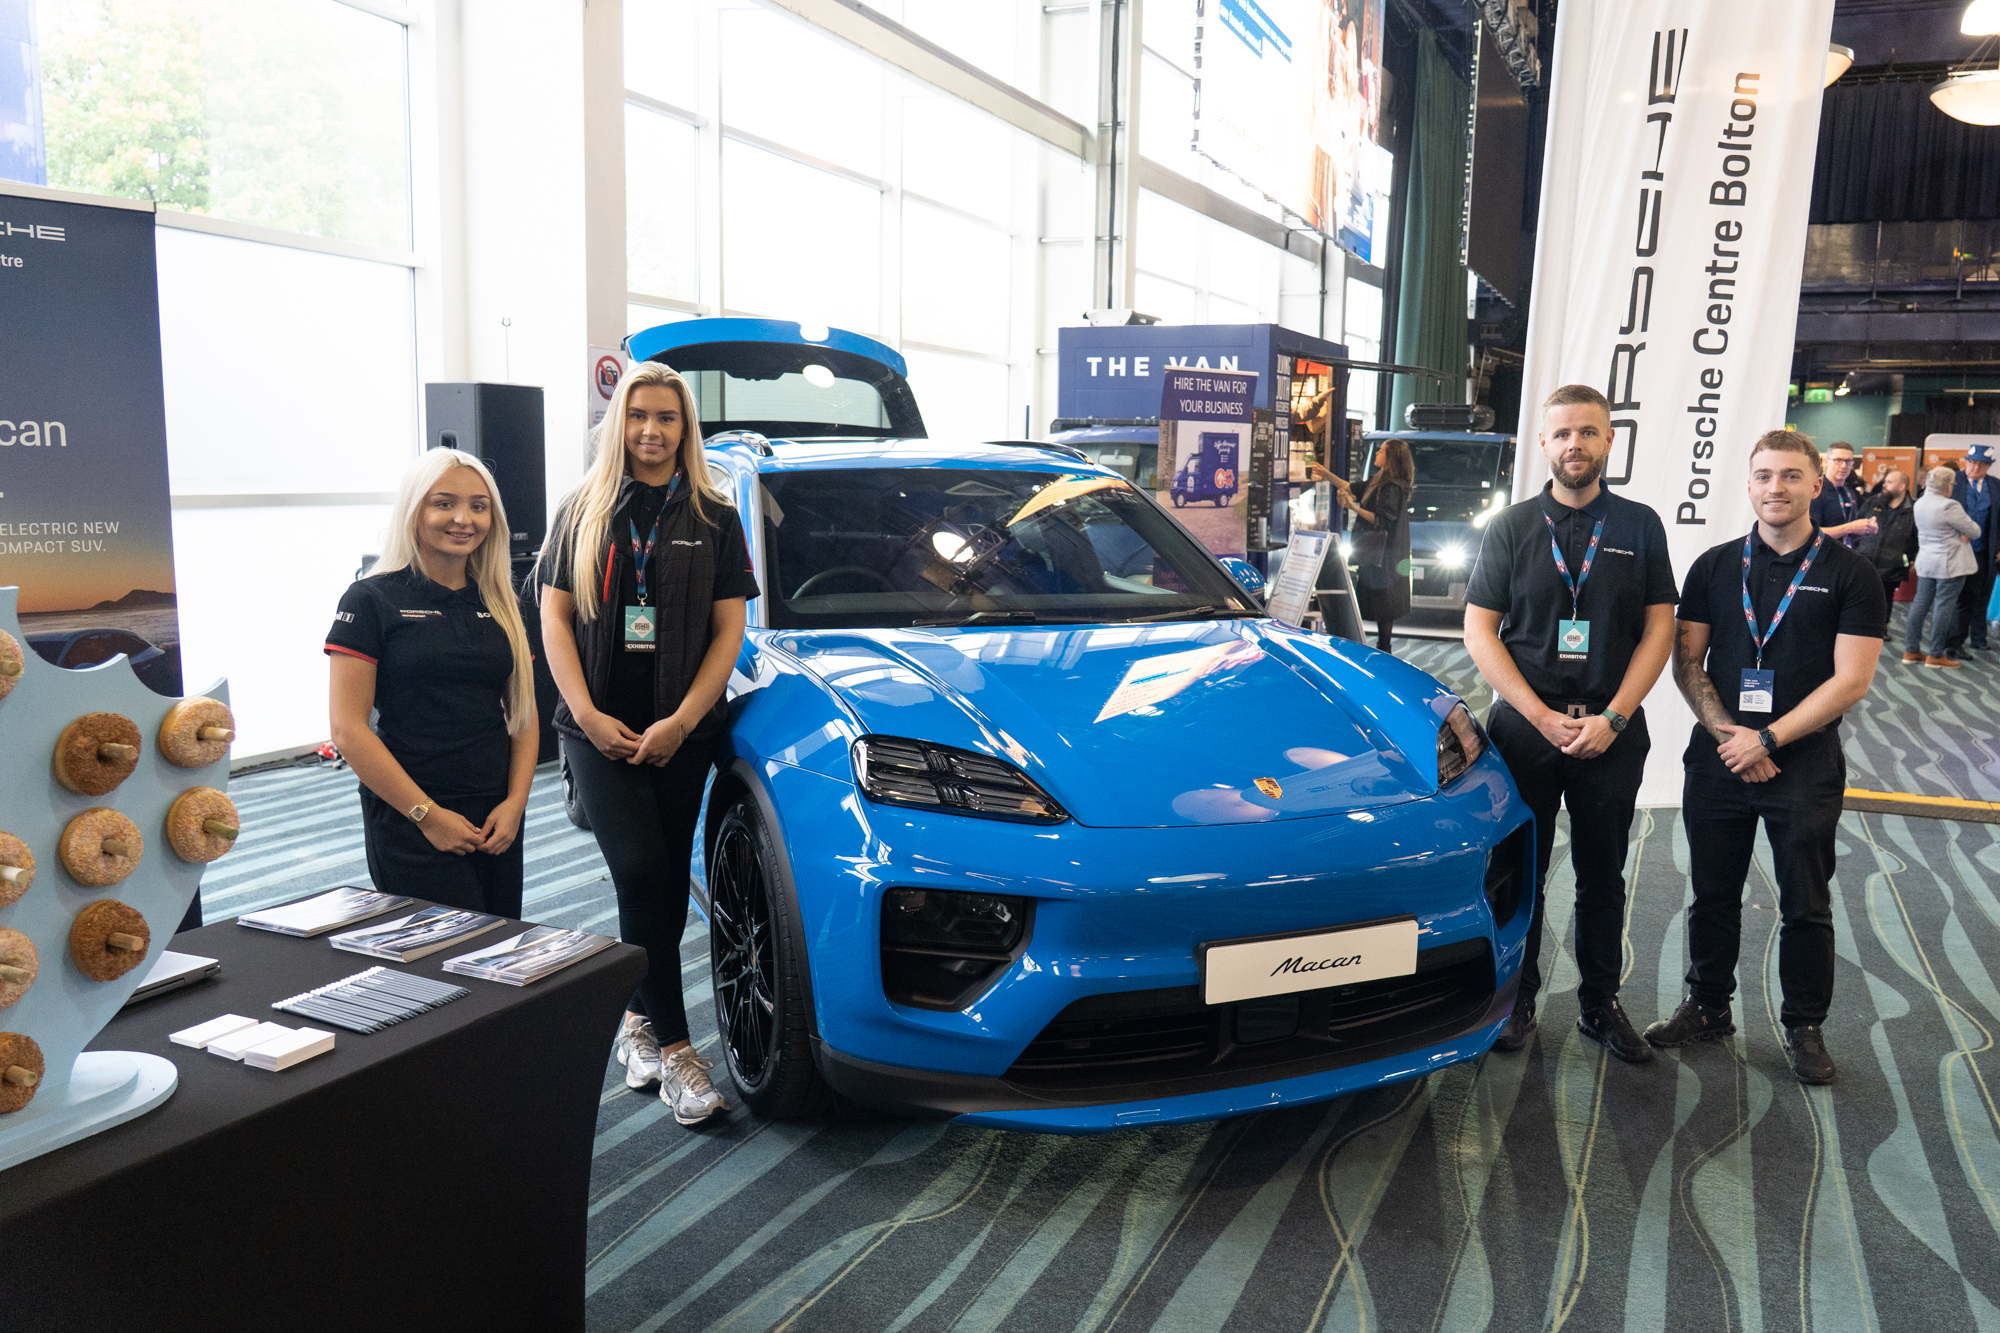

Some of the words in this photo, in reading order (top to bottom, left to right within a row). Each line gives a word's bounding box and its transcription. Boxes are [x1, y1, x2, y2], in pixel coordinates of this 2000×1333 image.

[1709, 72, 1760, 206] Bolton
[1604, 28, 1688, 485] ORSCHE
[1693, 220, 1743, 355] Centre
[1086, 356, 1150, 376] THE
[1173, 376, 1194, 390] HIRE
[1196, 378, 1212, 392] THE
[1213, 380, 1230, 393] VAN
[1232, 381, 1247, 394] FOR
[1180, 399, 1203, 412] YOUR
[1204, 401, 1243, 415] BUSINESS
[1676, 368, 1723, 525] Porsche
[0, 522, 78, 536] ELECTRIC
[83, 521, 120, 534] NEW
[71, 540, 106, 553] SUV.
[1270, 955, 1361, 977] Macan
